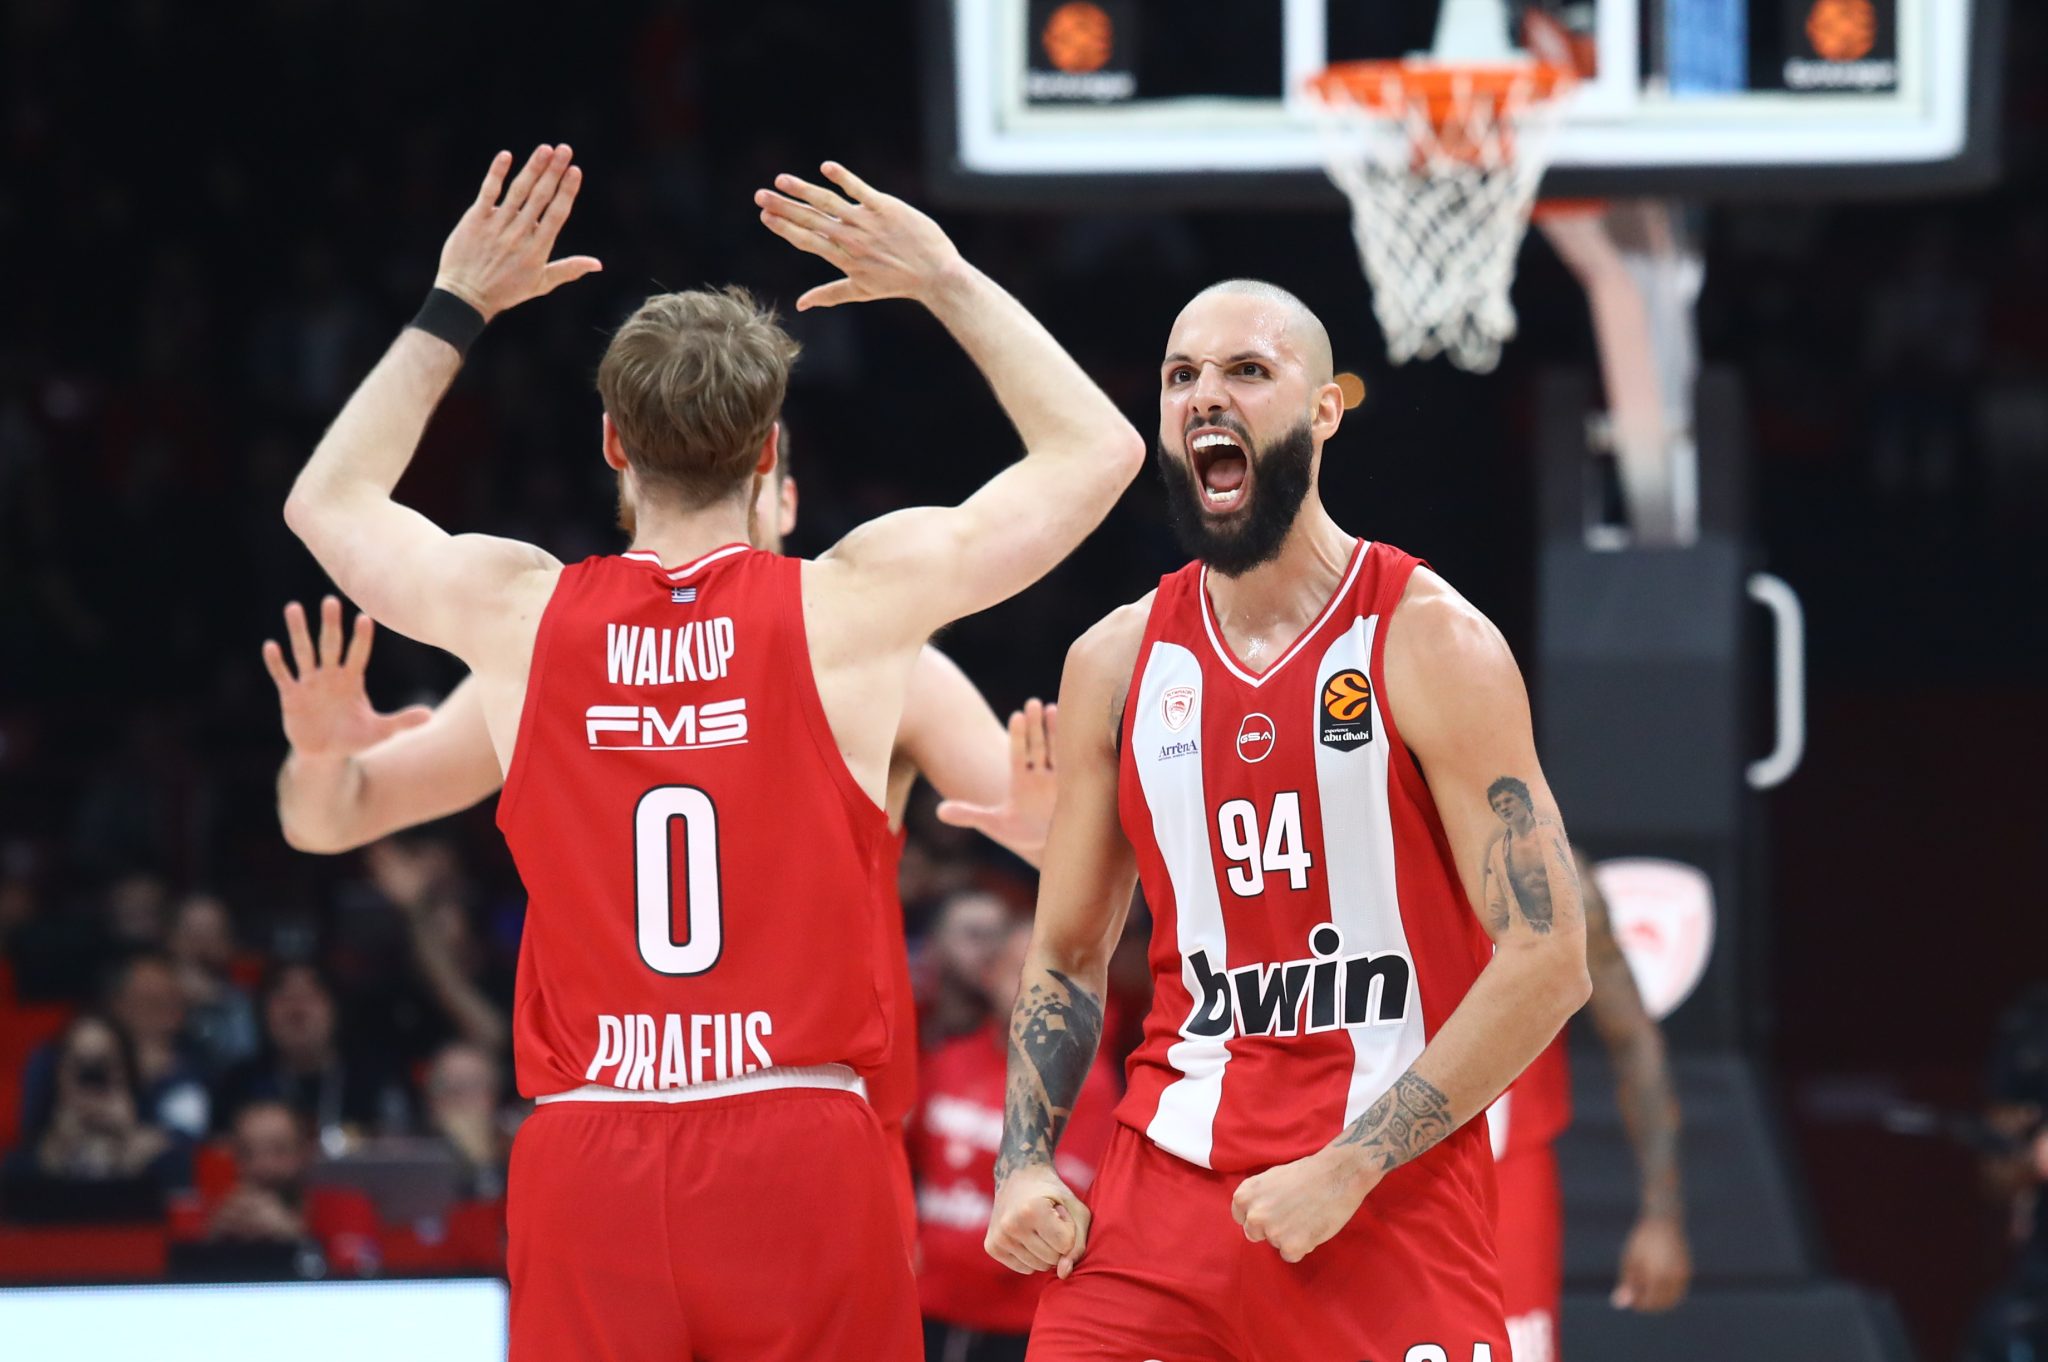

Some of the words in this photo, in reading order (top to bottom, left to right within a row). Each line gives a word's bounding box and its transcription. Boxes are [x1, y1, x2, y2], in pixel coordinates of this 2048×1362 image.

[607, 616, 735, 686] WALKUP
[585, 697, 749, 746] FMS
[1323, 733, 1342, 742] abu
[1342, 730, 1369, 741] dhabi
[633, 784, 723, 977] 0
[1217, 791, 1313, 897] 94
[1178, 922, 1412, 1037] bwin
